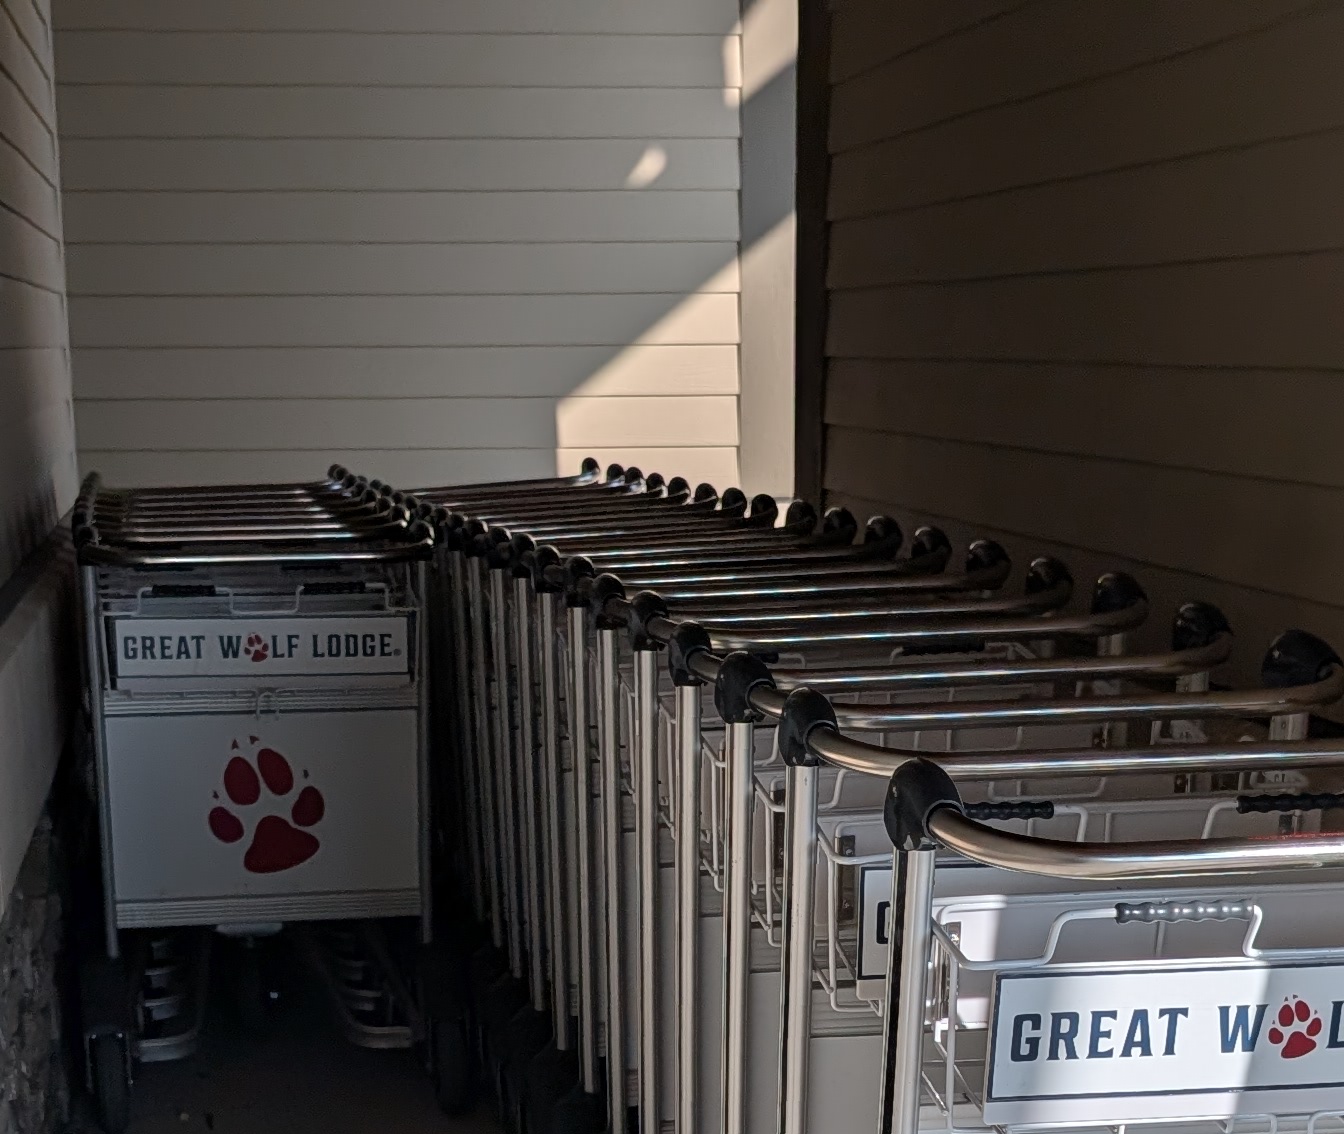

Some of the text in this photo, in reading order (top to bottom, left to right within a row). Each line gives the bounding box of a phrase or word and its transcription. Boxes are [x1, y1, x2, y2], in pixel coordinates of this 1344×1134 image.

[123, 635, 206, 660] GREAT
[217, 633, 301, 662] WLF
[1010, 1006, 1190, 1064] GREAT
